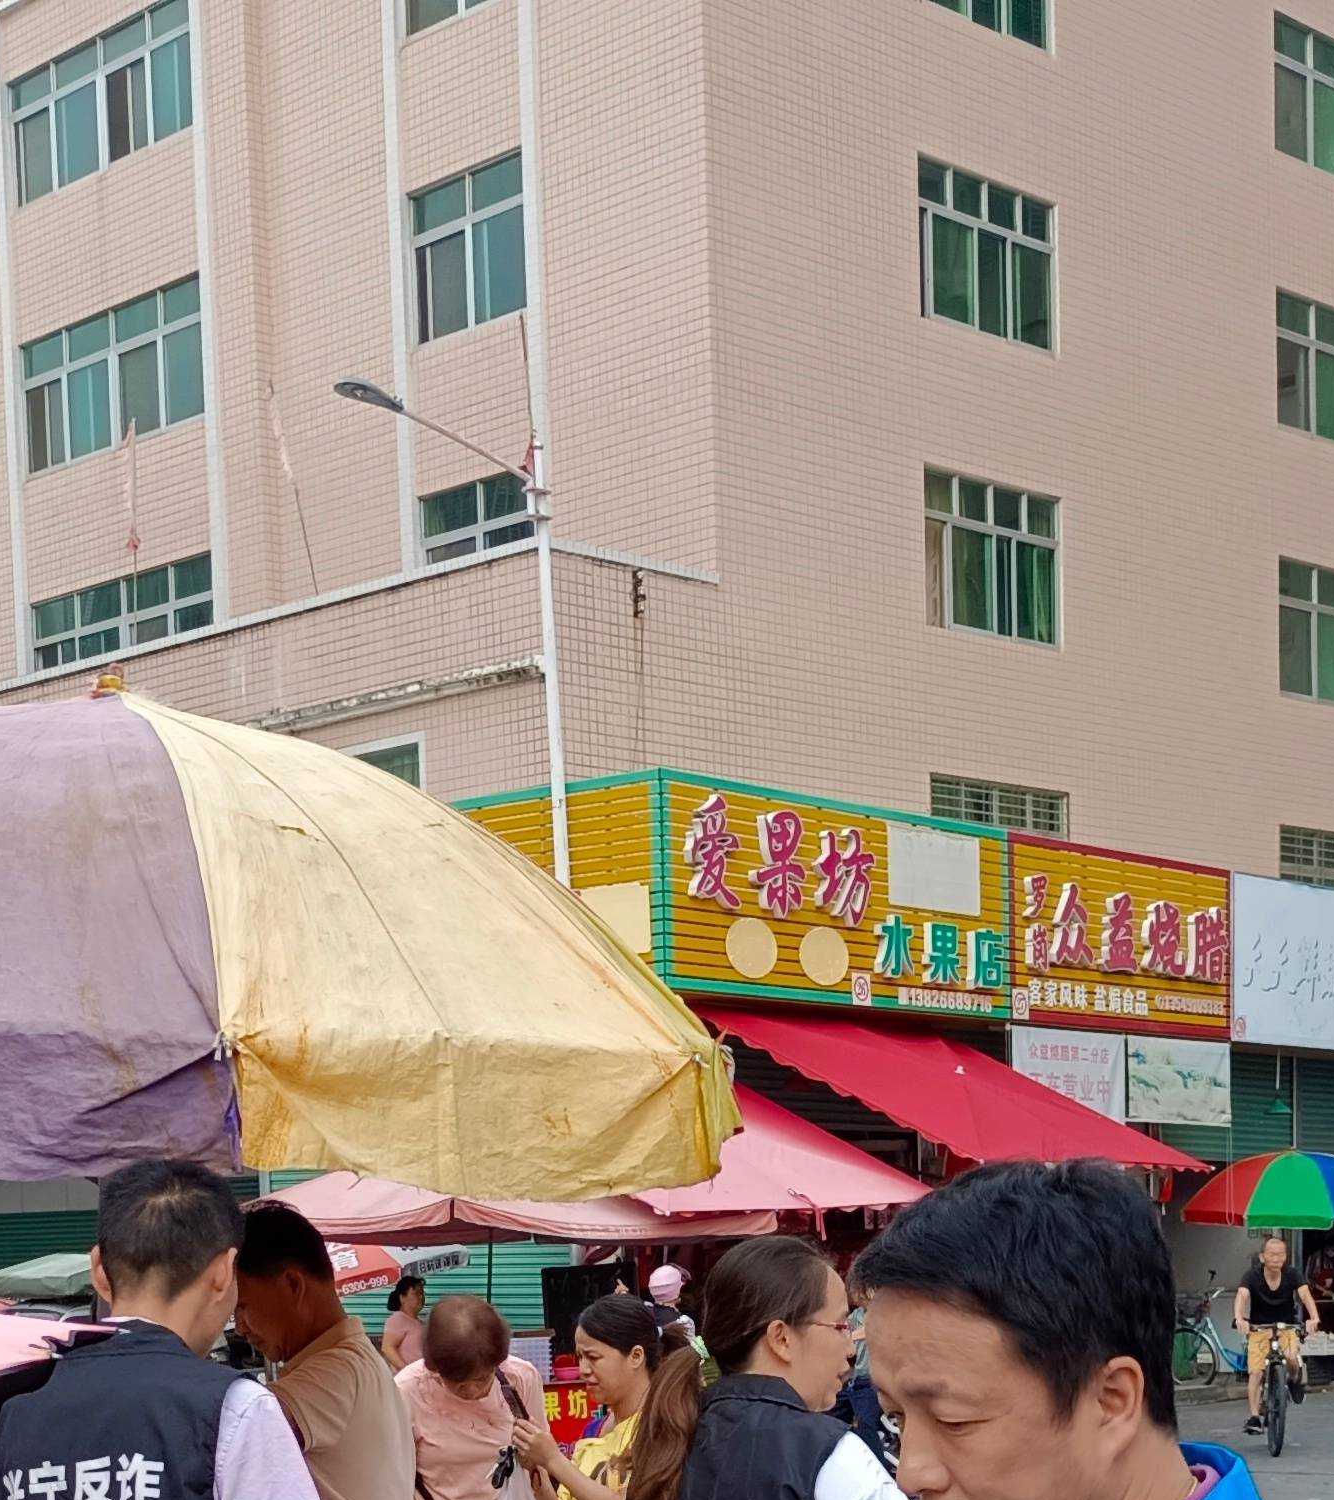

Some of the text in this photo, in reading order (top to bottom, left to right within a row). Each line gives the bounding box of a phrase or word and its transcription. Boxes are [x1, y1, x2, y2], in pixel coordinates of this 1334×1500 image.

[684, 794, 876, 928] 爱果坊
[873, 914, 1005, 989] 水果店
[1049, 882, 1230, 984] 众益烧腊
[1028, 978, 1088, 1009] 客家风味
